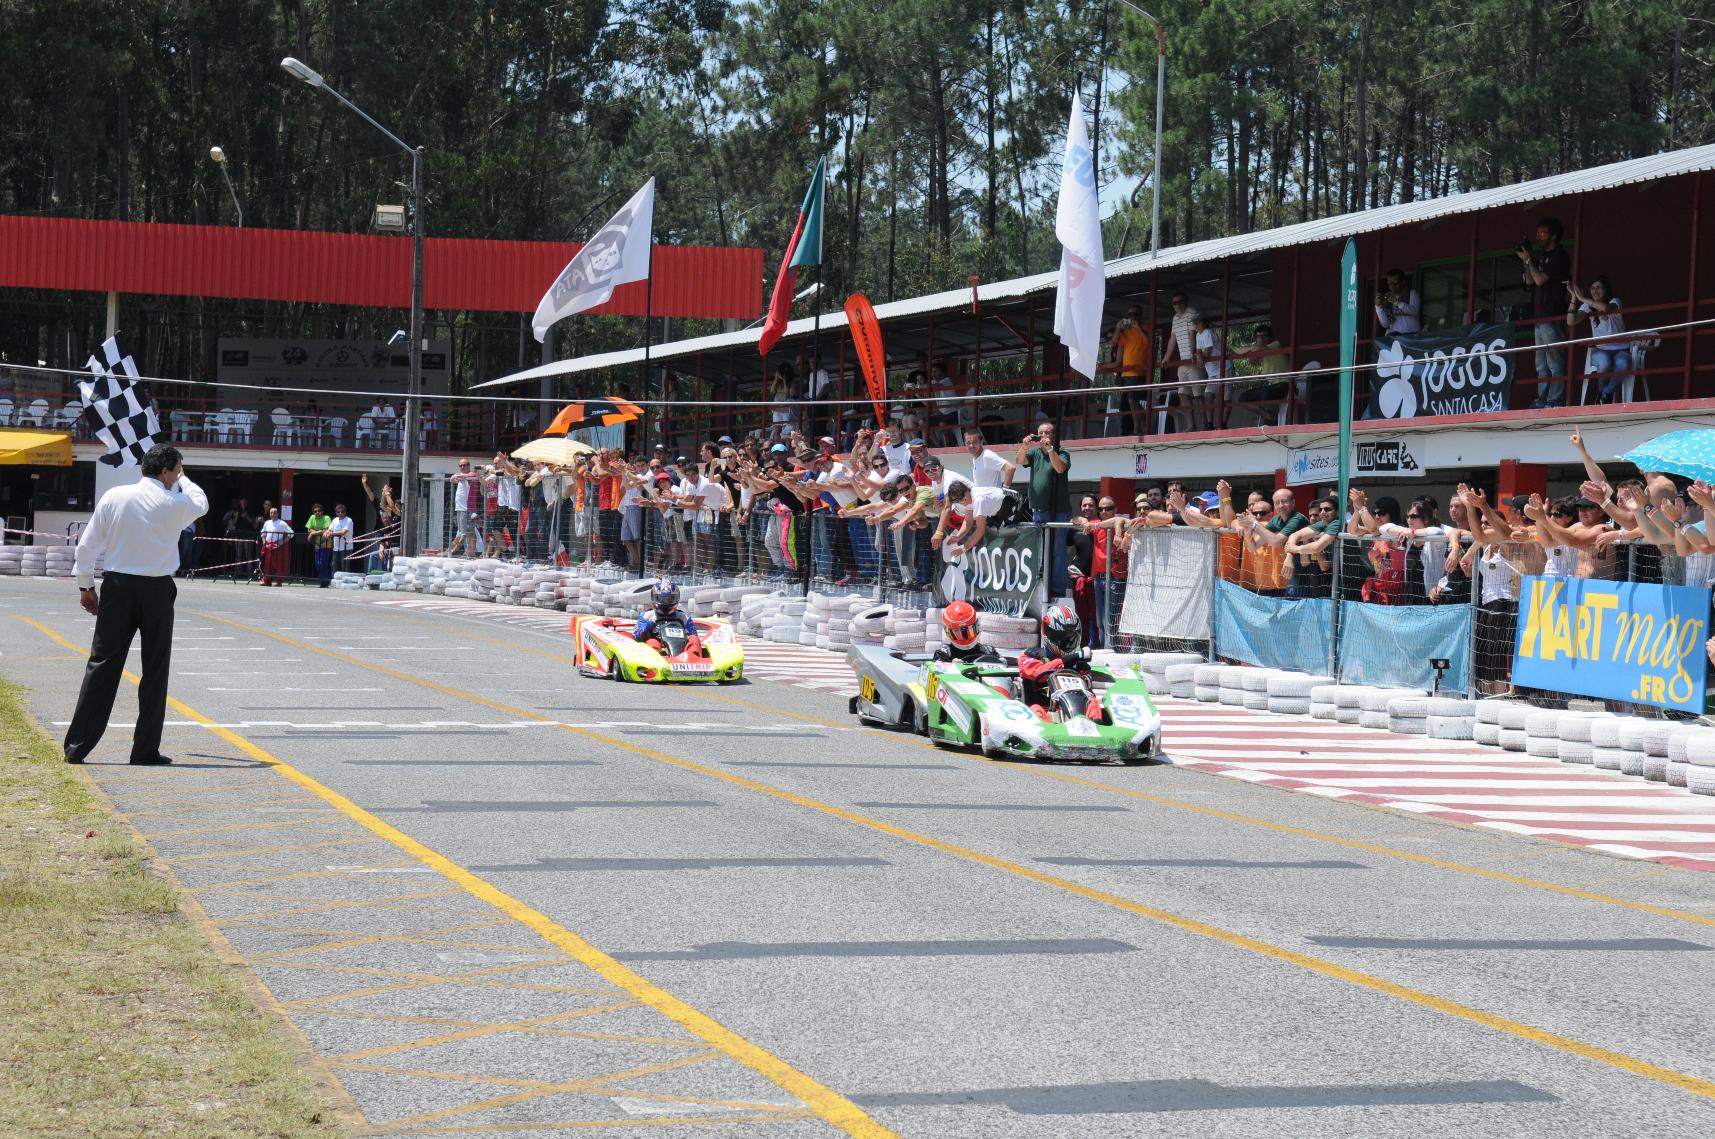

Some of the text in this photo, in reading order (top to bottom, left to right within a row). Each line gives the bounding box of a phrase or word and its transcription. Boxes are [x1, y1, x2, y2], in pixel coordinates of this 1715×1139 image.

[1421, 338, 1507, 411] JOGOS
[1357, 443, 1375, 470] VIRUS
[970, 546, 1033, 603] JOGOS
[672, 663, 712, 671] UNITRIP
[861, 675, 874, 702] 125
